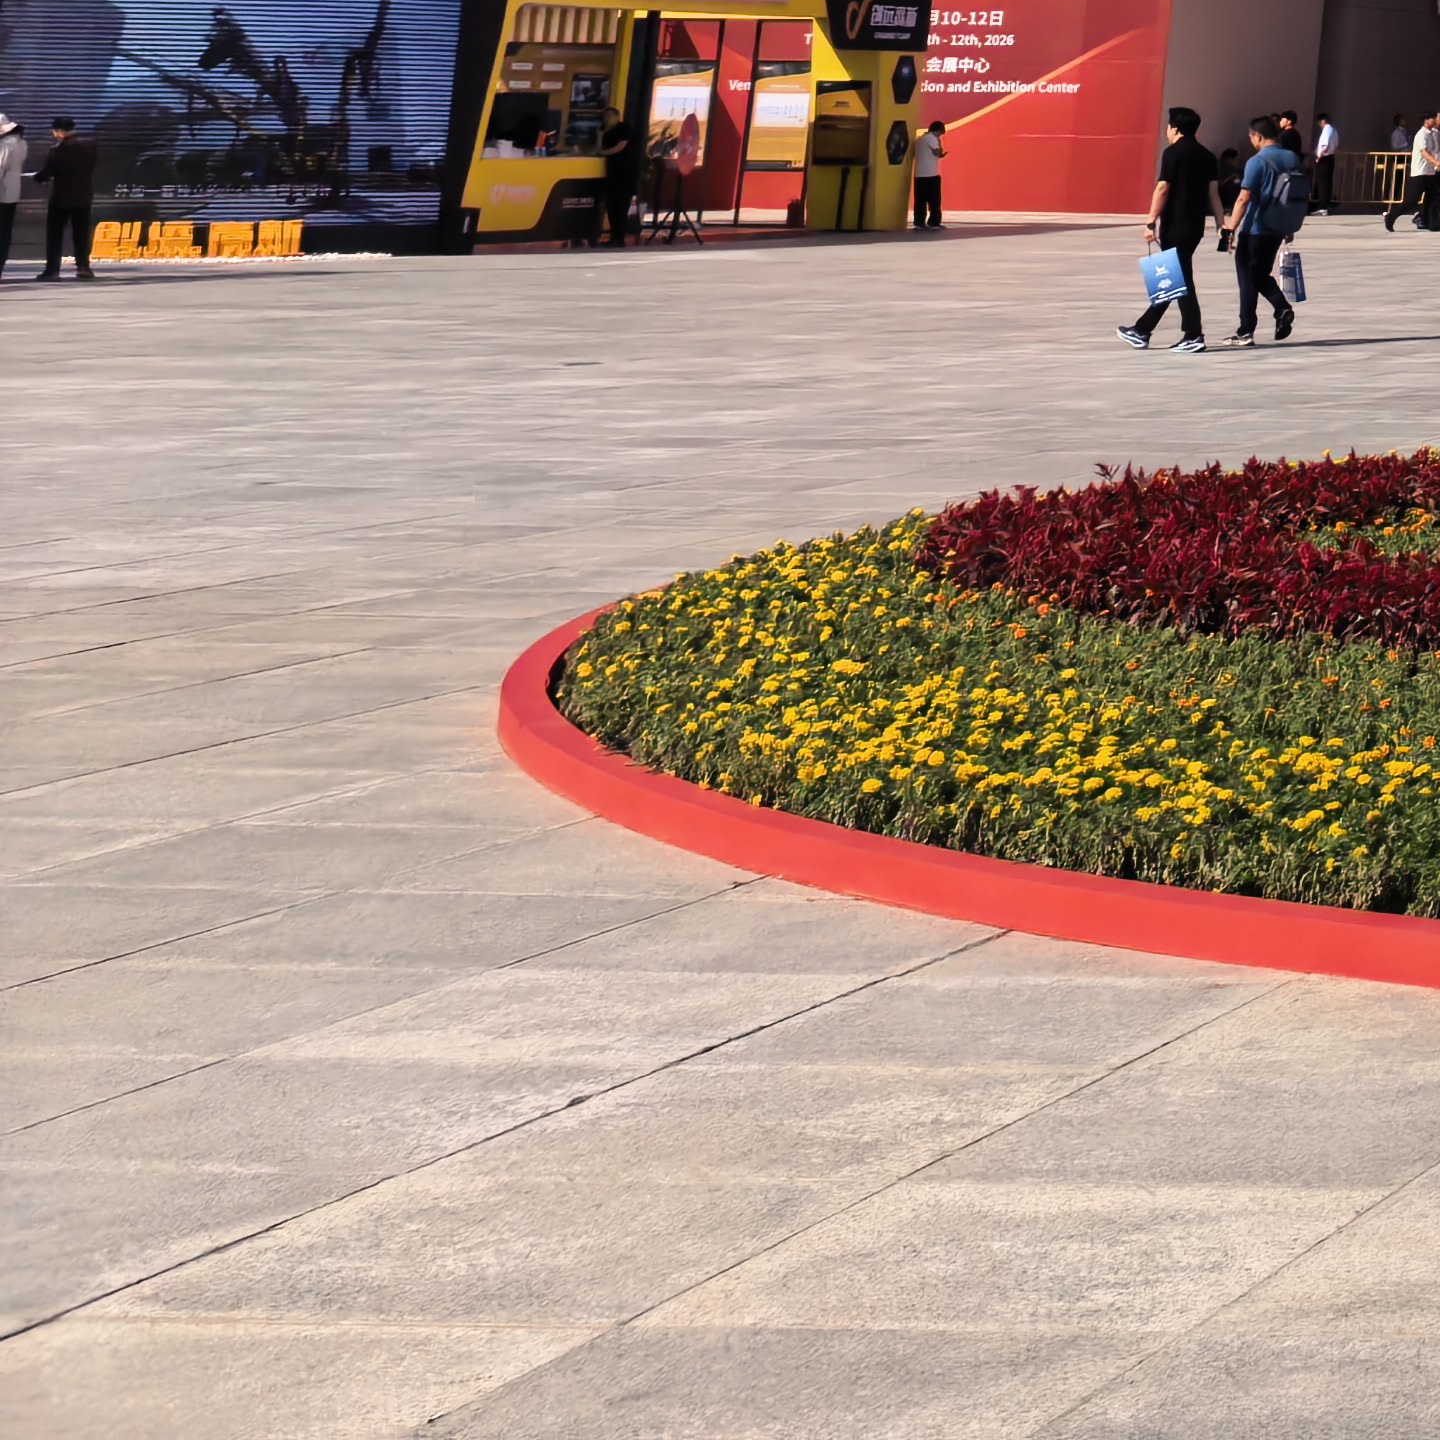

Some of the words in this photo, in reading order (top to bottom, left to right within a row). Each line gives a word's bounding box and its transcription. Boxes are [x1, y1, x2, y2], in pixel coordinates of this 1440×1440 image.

[950, 34, 982, 50] 12th,
[984, 35, 1014, 45] 2026
[947, 81, 971, 92] and
[972, 79, 1036, 96] Exhibition
[1038, 80, 1080, 95] Center
